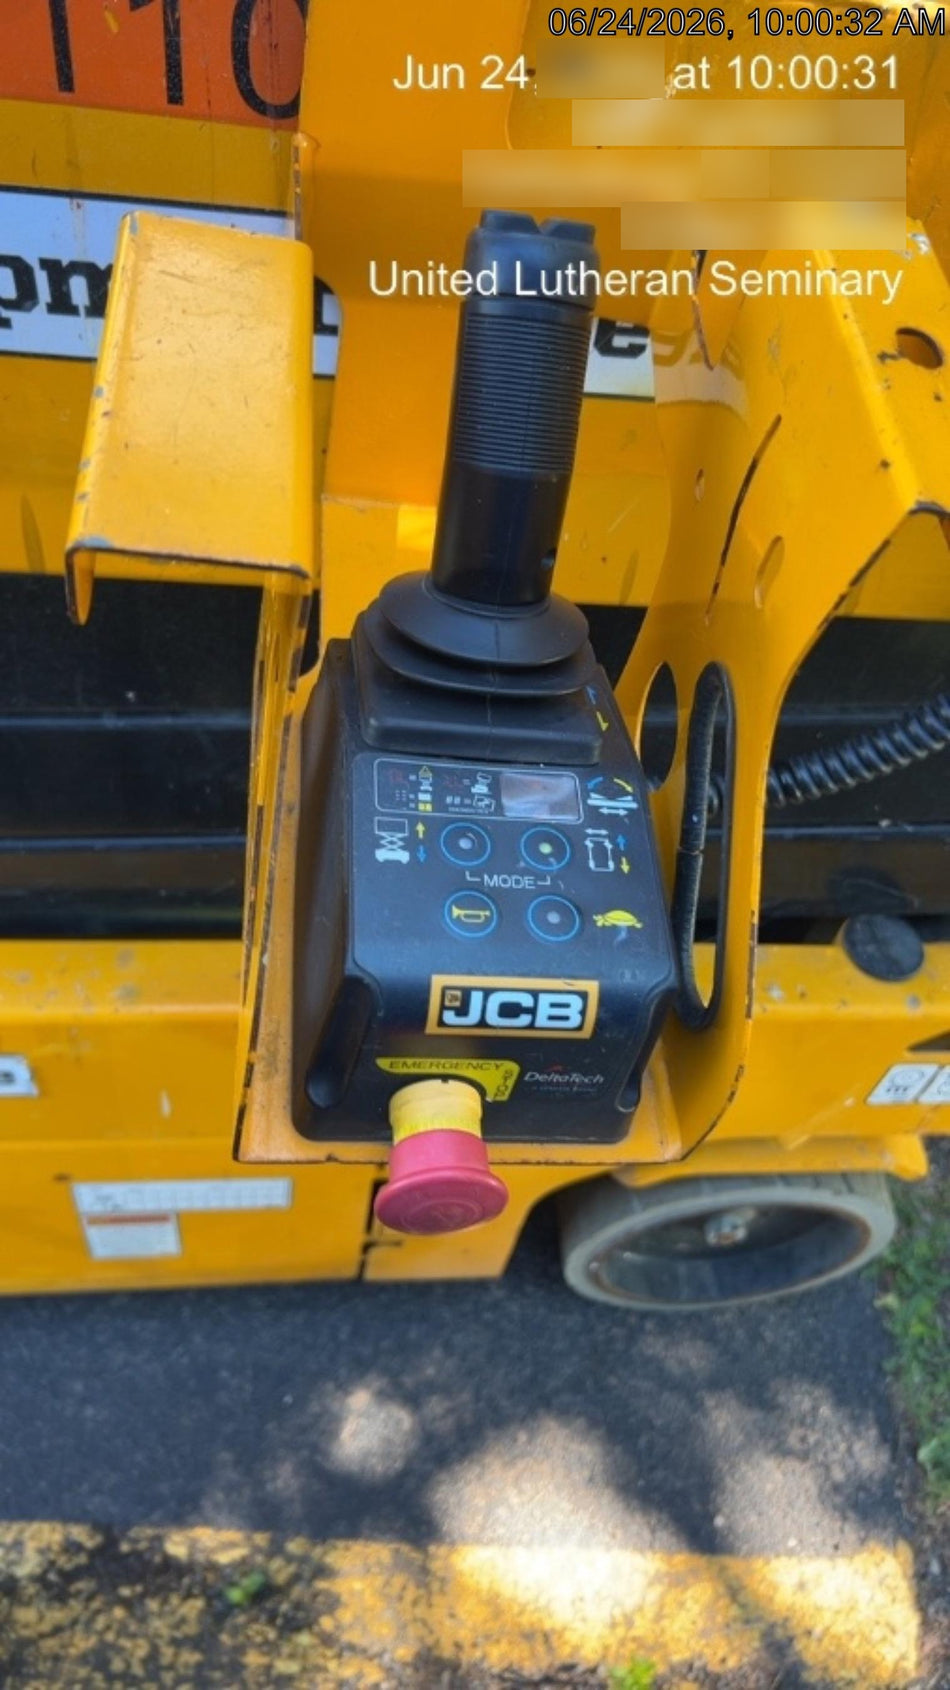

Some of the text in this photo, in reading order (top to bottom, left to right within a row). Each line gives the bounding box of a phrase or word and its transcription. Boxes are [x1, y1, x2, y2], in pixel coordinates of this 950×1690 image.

[483, 874, 536, 889] MODE
[442, 990, 583, 1030] JCB
[389, 1060, 505, 1072] EMERGENCY
[493, 1069, 513, 1099] STOP
[523, 1071, 605, 1084] DeltaTech
